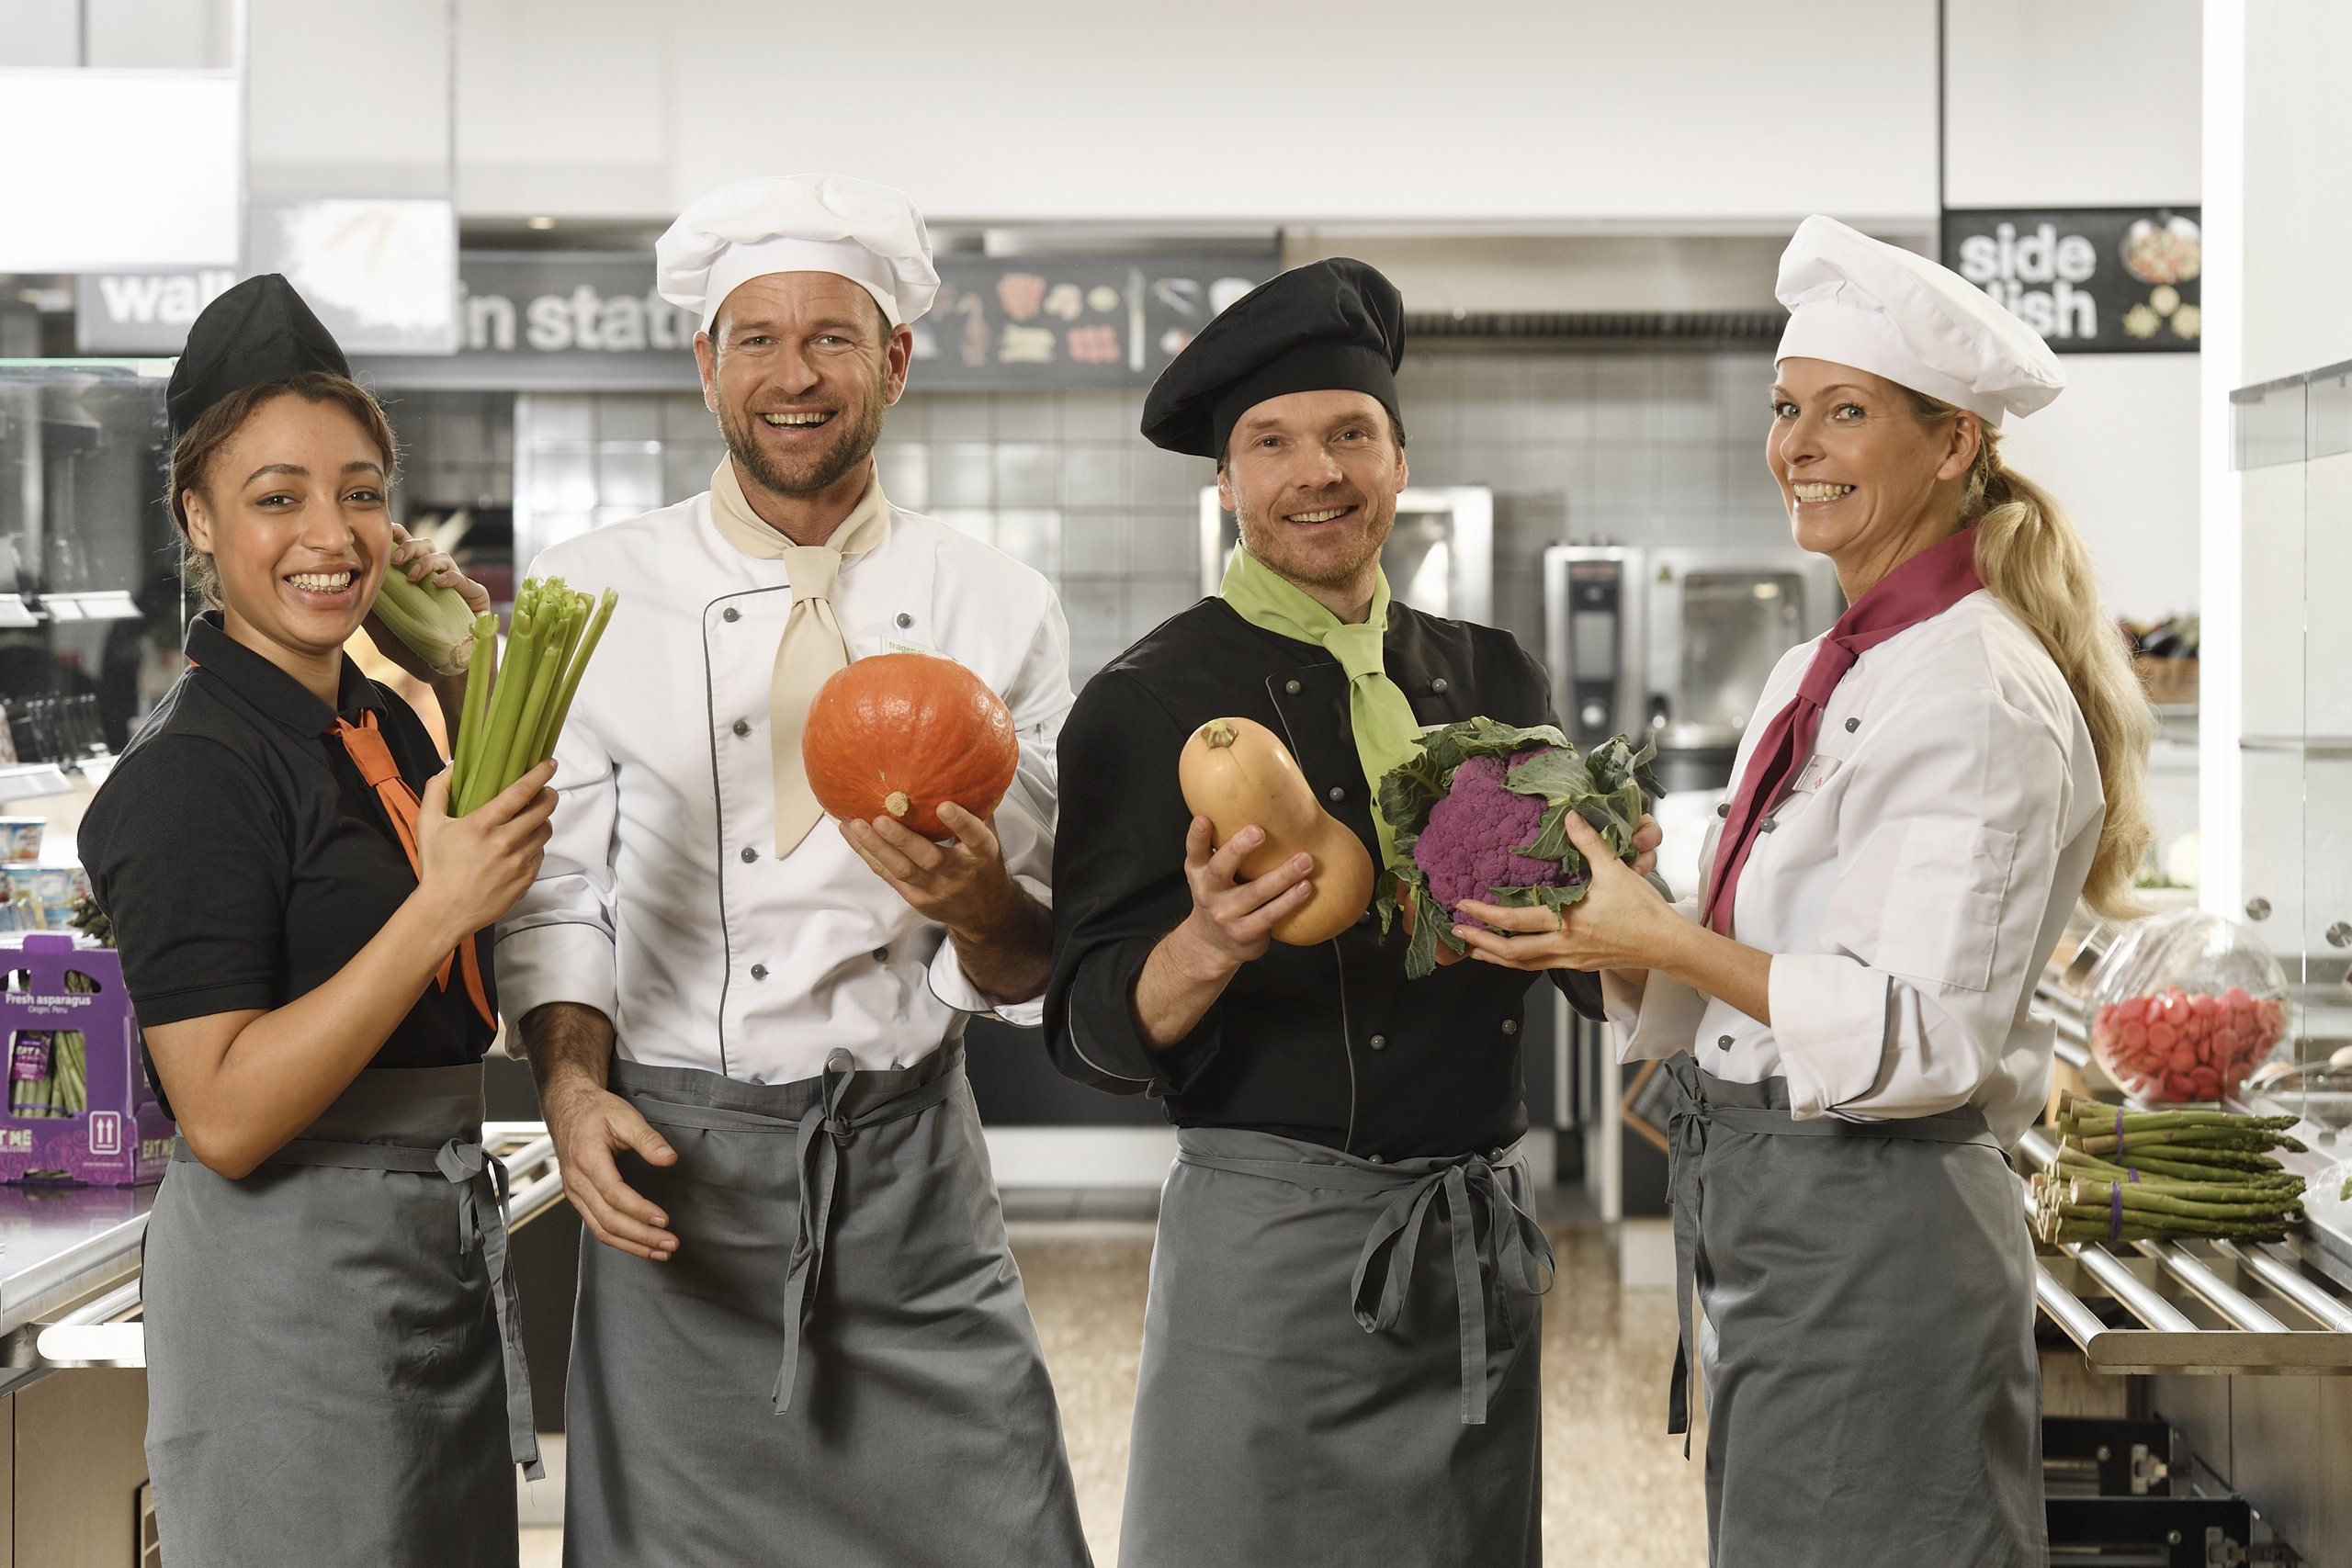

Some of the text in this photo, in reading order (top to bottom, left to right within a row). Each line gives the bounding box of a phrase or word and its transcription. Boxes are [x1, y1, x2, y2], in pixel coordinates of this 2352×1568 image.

[1959, 222, 2097, 283] side
[6, 993, 91, 1008] Fresh asparagus
[8, 1129, 32, 1147] ME
